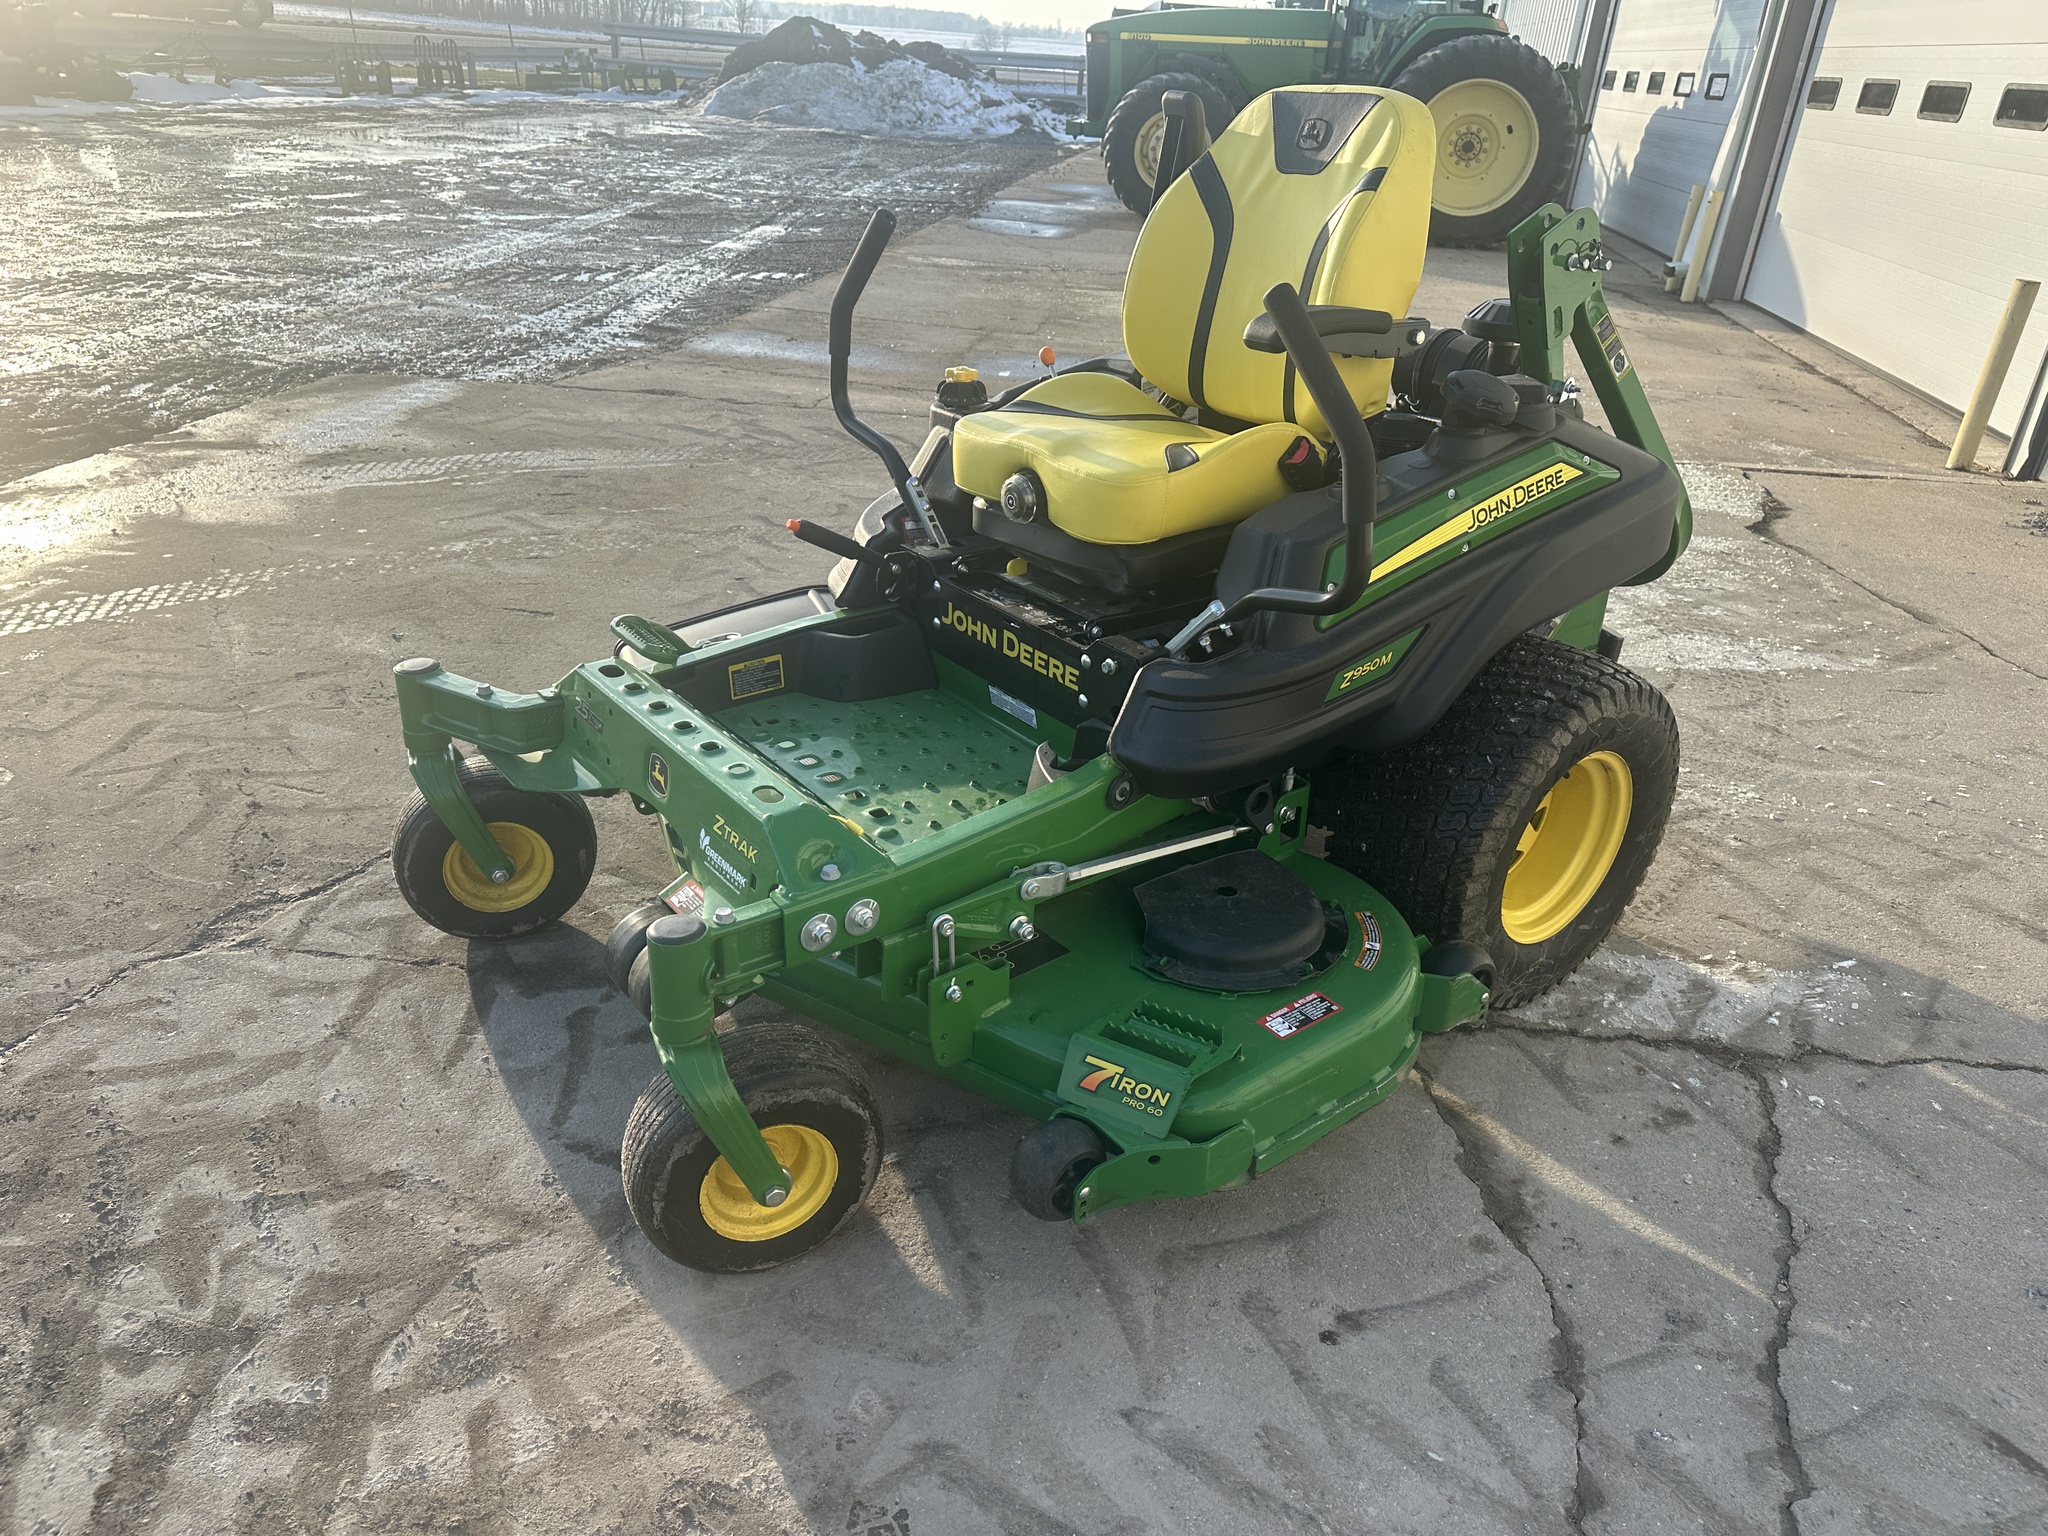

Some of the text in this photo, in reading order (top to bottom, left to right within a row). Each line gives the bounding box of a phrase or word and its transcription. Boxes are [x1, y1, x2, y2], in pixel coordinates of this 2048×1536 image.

[1246, 38, 1305, 47] JOHN DEERE
[1467, 469, 1566, 531] JOHN DEERE
[942, 602, 1080, 691] JOHN DEERE
[1339, 651, 1394, 690] Z950M
[712, 813, 759, 864] ZTRAK
[705, 845, 747, 888] GREENMARK
[1121, 1096, 1164, 1117] PRO 60
